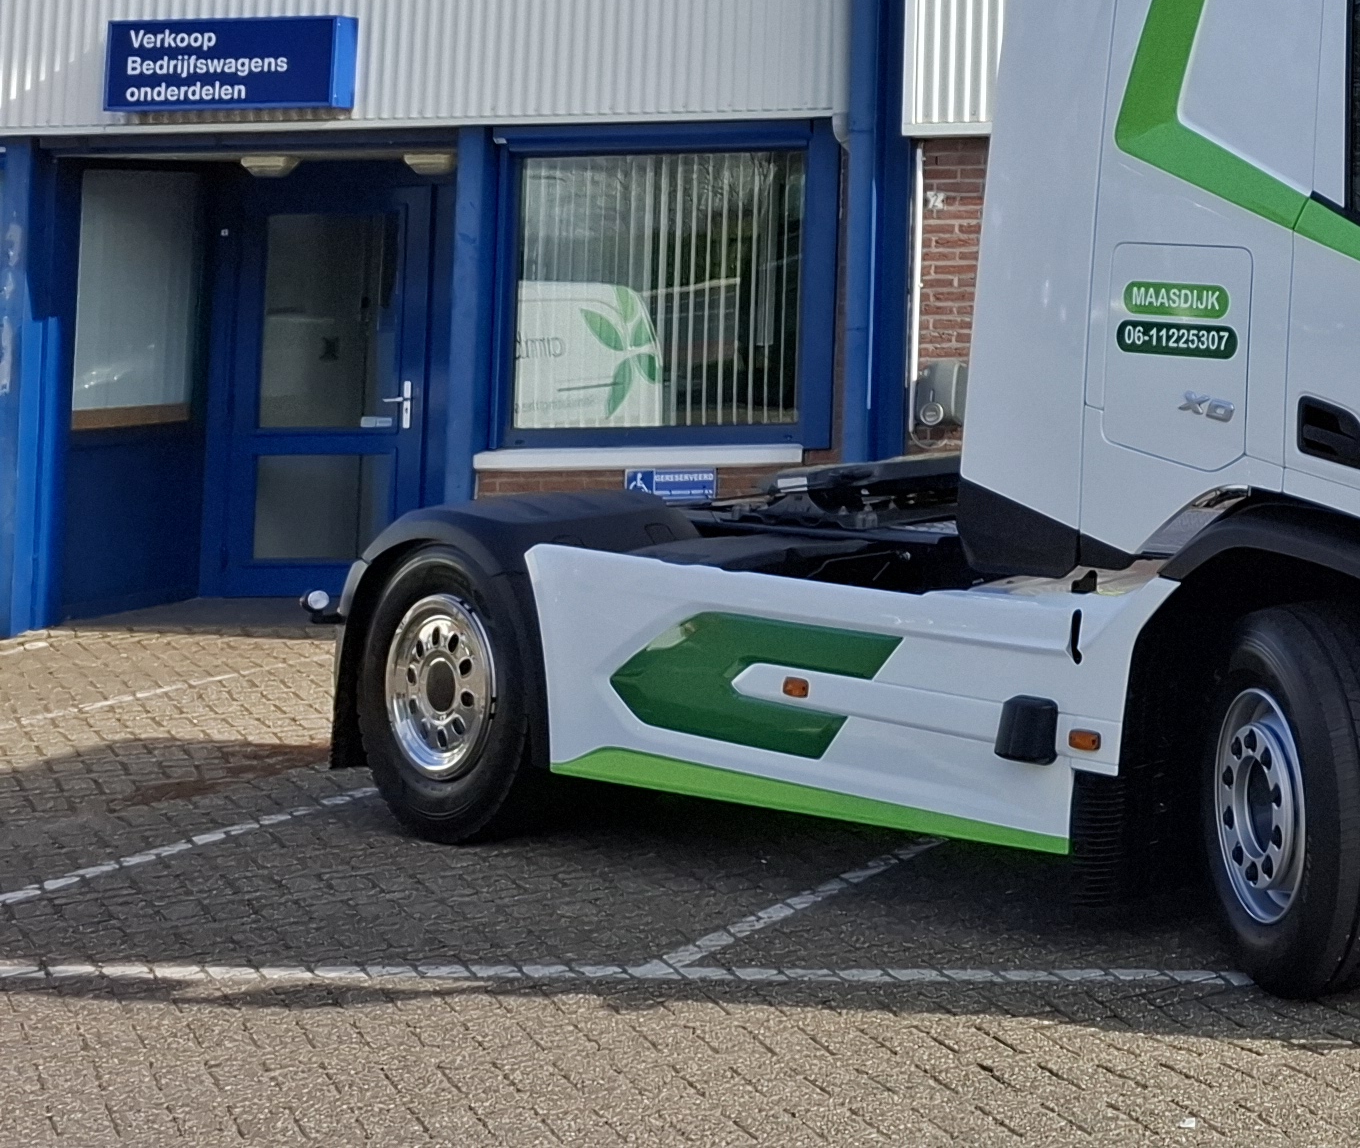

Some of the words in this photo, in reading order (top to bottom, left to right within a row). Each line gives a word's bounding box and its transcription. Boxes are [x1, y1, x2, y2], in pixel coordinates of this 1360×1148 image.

[129, 29, 217, 51] Verkoop
[126, 55, 288, 77] Bedrijfswagens
[125, 81, 246, 102] onderdelen
[1132, 286, 1220, 311] MAASDIJK
[1124, 325, 1230, 351] 06-11225307
